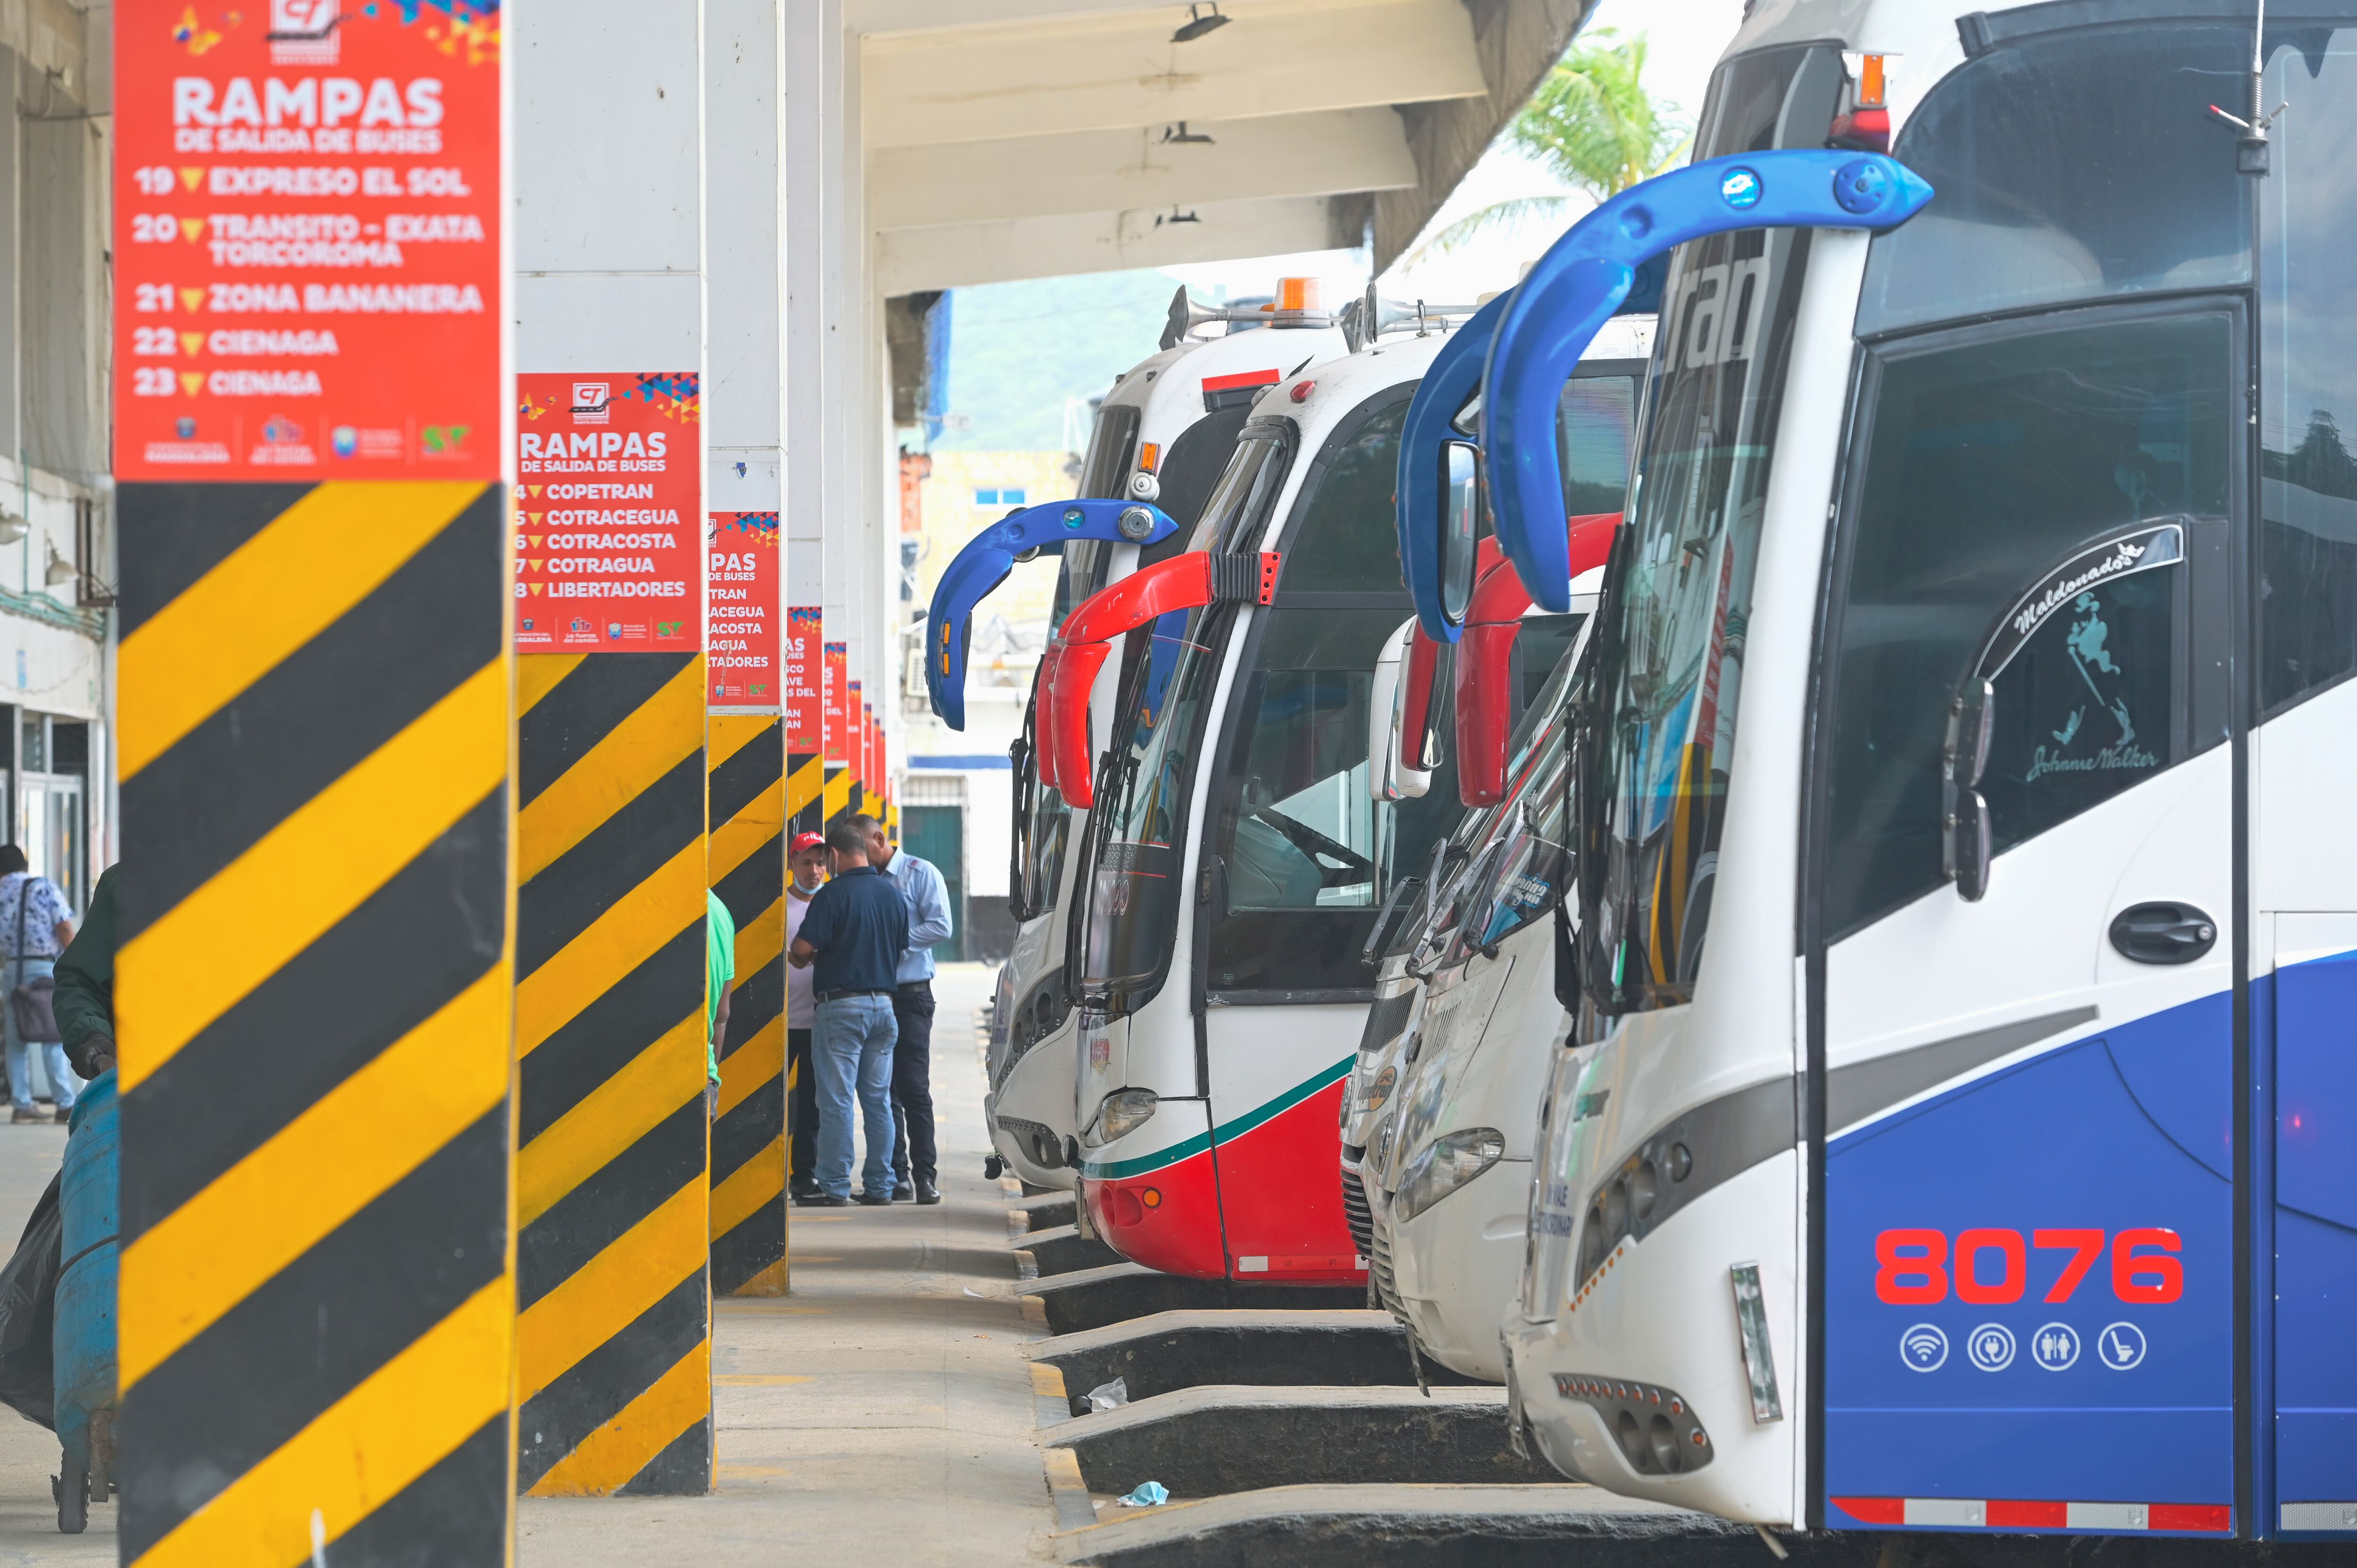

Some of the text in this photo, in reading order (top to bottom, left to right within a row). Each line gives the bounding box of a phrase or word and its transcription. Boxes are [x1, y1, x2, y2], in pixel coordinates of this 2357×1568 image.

[173, 77, 444, 127] RAMPAS
[175, 129, 442, 153] DE SALIDA DE BUSES
[134, 167, 471, 196] 19 EXPRESO EL SOL
[133, 214, 178, 242] 20
[208, 215, 361, 239] TRANSITO
[385, 215, 485, 240] EXATA
[208, 241, 404, 266] TORCOROMA
[135, 284, 484, 312] 21 ZONA BANANERA
[134, 327, 339, 355] 22 CIENAGA
[134, 367, 322, 396] 23 CIENAGA
[520, 432, 667, 458] RAMPAS
[521, 460, 666, 472] DE SALIDA DE BUSES
[547, 484, 653, 499] COPETRAN
[514, 510, 680, 526] 5 COTRACEGUA
[513, 533, 677, 549] 6 COTRACOSTA
[514, 558, 655, 573] 7 COTRAGUA
[711, 553, 756, 571] PAS
[709, 572, 755, 581] DE BUSES
[514, 581, 686, 598] 8 LIBERTADORES
[709, 589, 746, 599] TRAN
[709, 607, 765, 617] ACEGUA
[709, 623, 762, 634] ACOSTA
[709, 640, 747, 651] AGUA
[708, 657, 768, 667] TADORES
[796, 688, 816, 697] DEL
[2096, 744, 2159, 769] Walker
[1875, 1229, 2184, 1304] 8076
